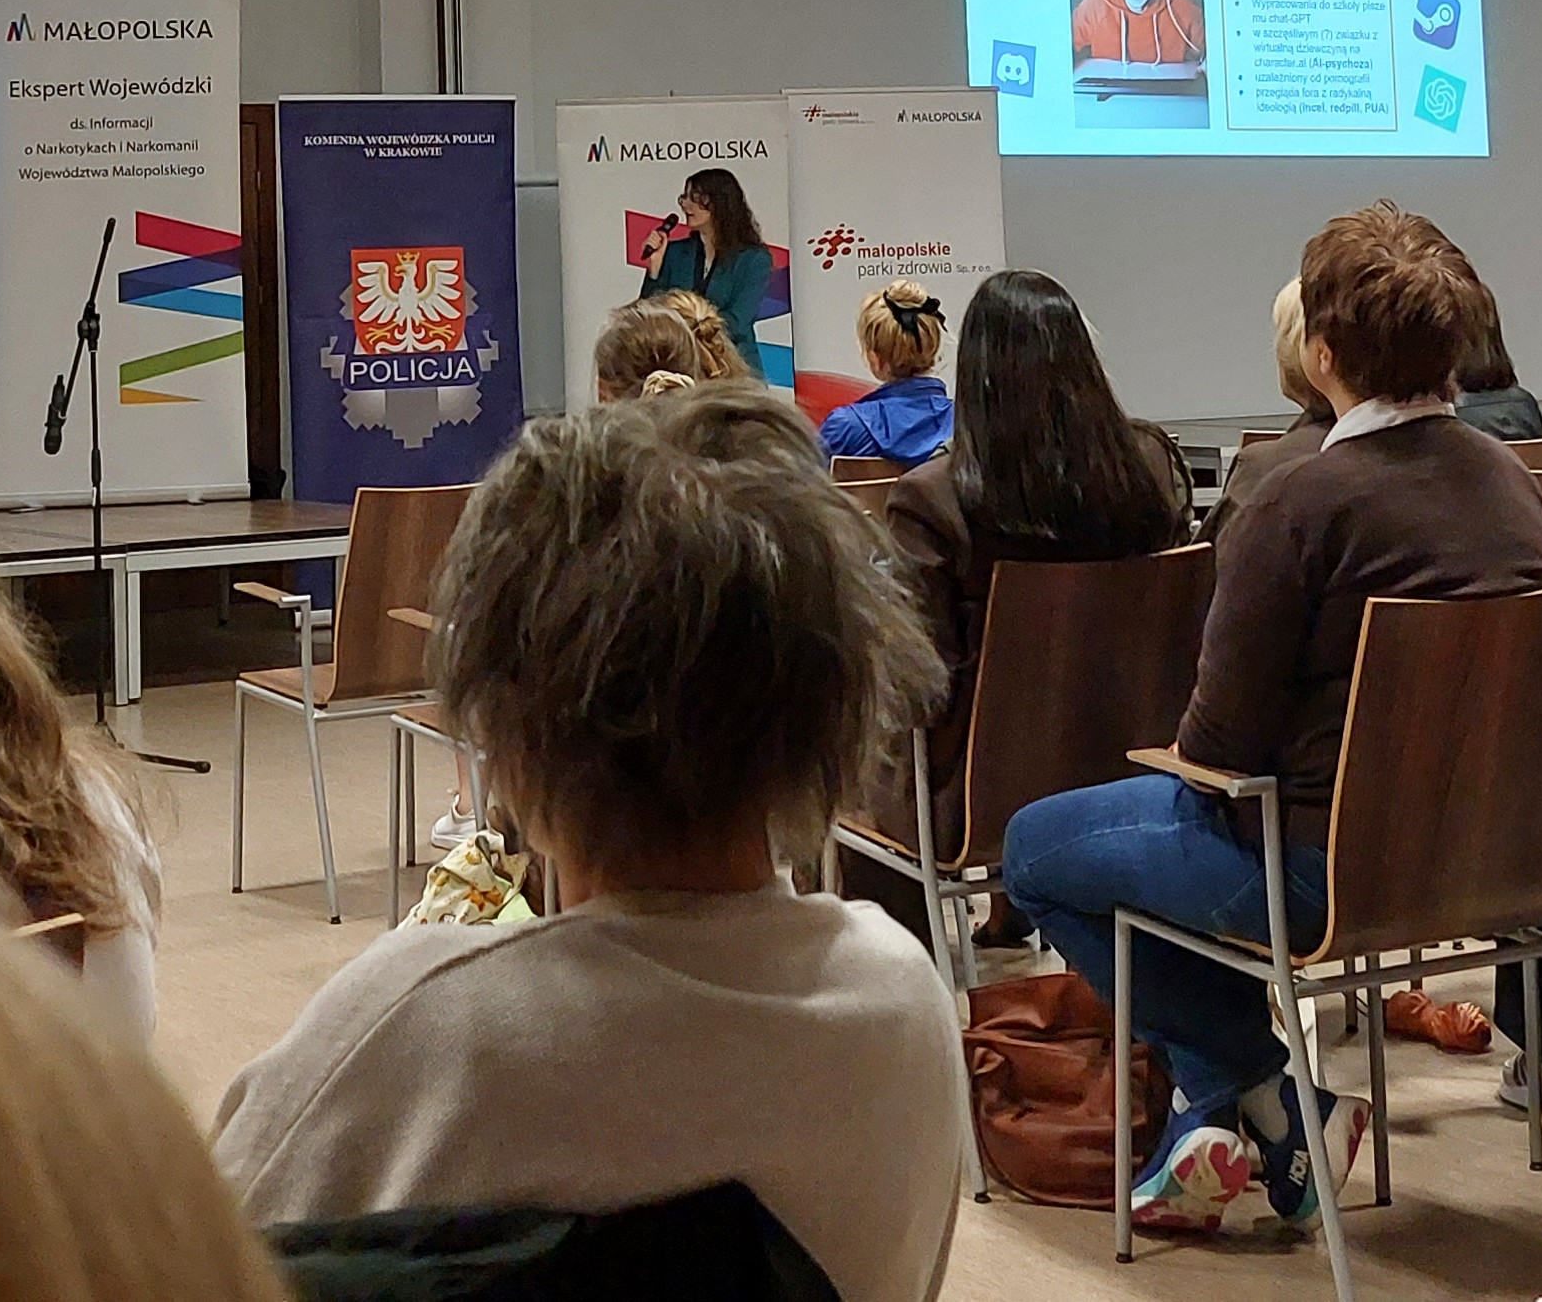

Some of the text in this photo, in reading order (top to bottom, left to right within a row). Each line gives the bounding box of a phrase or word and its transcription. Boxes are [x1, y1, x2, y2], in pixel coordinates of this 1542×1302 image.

[1320, 0, 1330, 9] do
[44, 20, 213, 41] MAŁOPOLSKA
[9, 77, 212, 101] Ekspert Wojewódzki
[70, 117, 153, 131] ds. Informacji
[912, 111, 981, 122] MAŁOPOLSKA
[304, 133, 495, 146] KOMENDA WOJEWÓDZKA POLICJI
[25, 147, 33, 155] o
[36, 142, 116, 156] Narkotykach
[127, 140, 199, 153] Narkomanii
[364, 147, 442, 157] W KRAKOWIE
[621, 140, 768, 162] MAŁOPOLSKA
[19, 167, 109, 182] Województwa
[858, 242, 951, 260] małopolskie
[858, 261, 892, 279] parki
[898, 261, 951, 275] zdrowia
[350, 356, 476, 385] POLICJA
